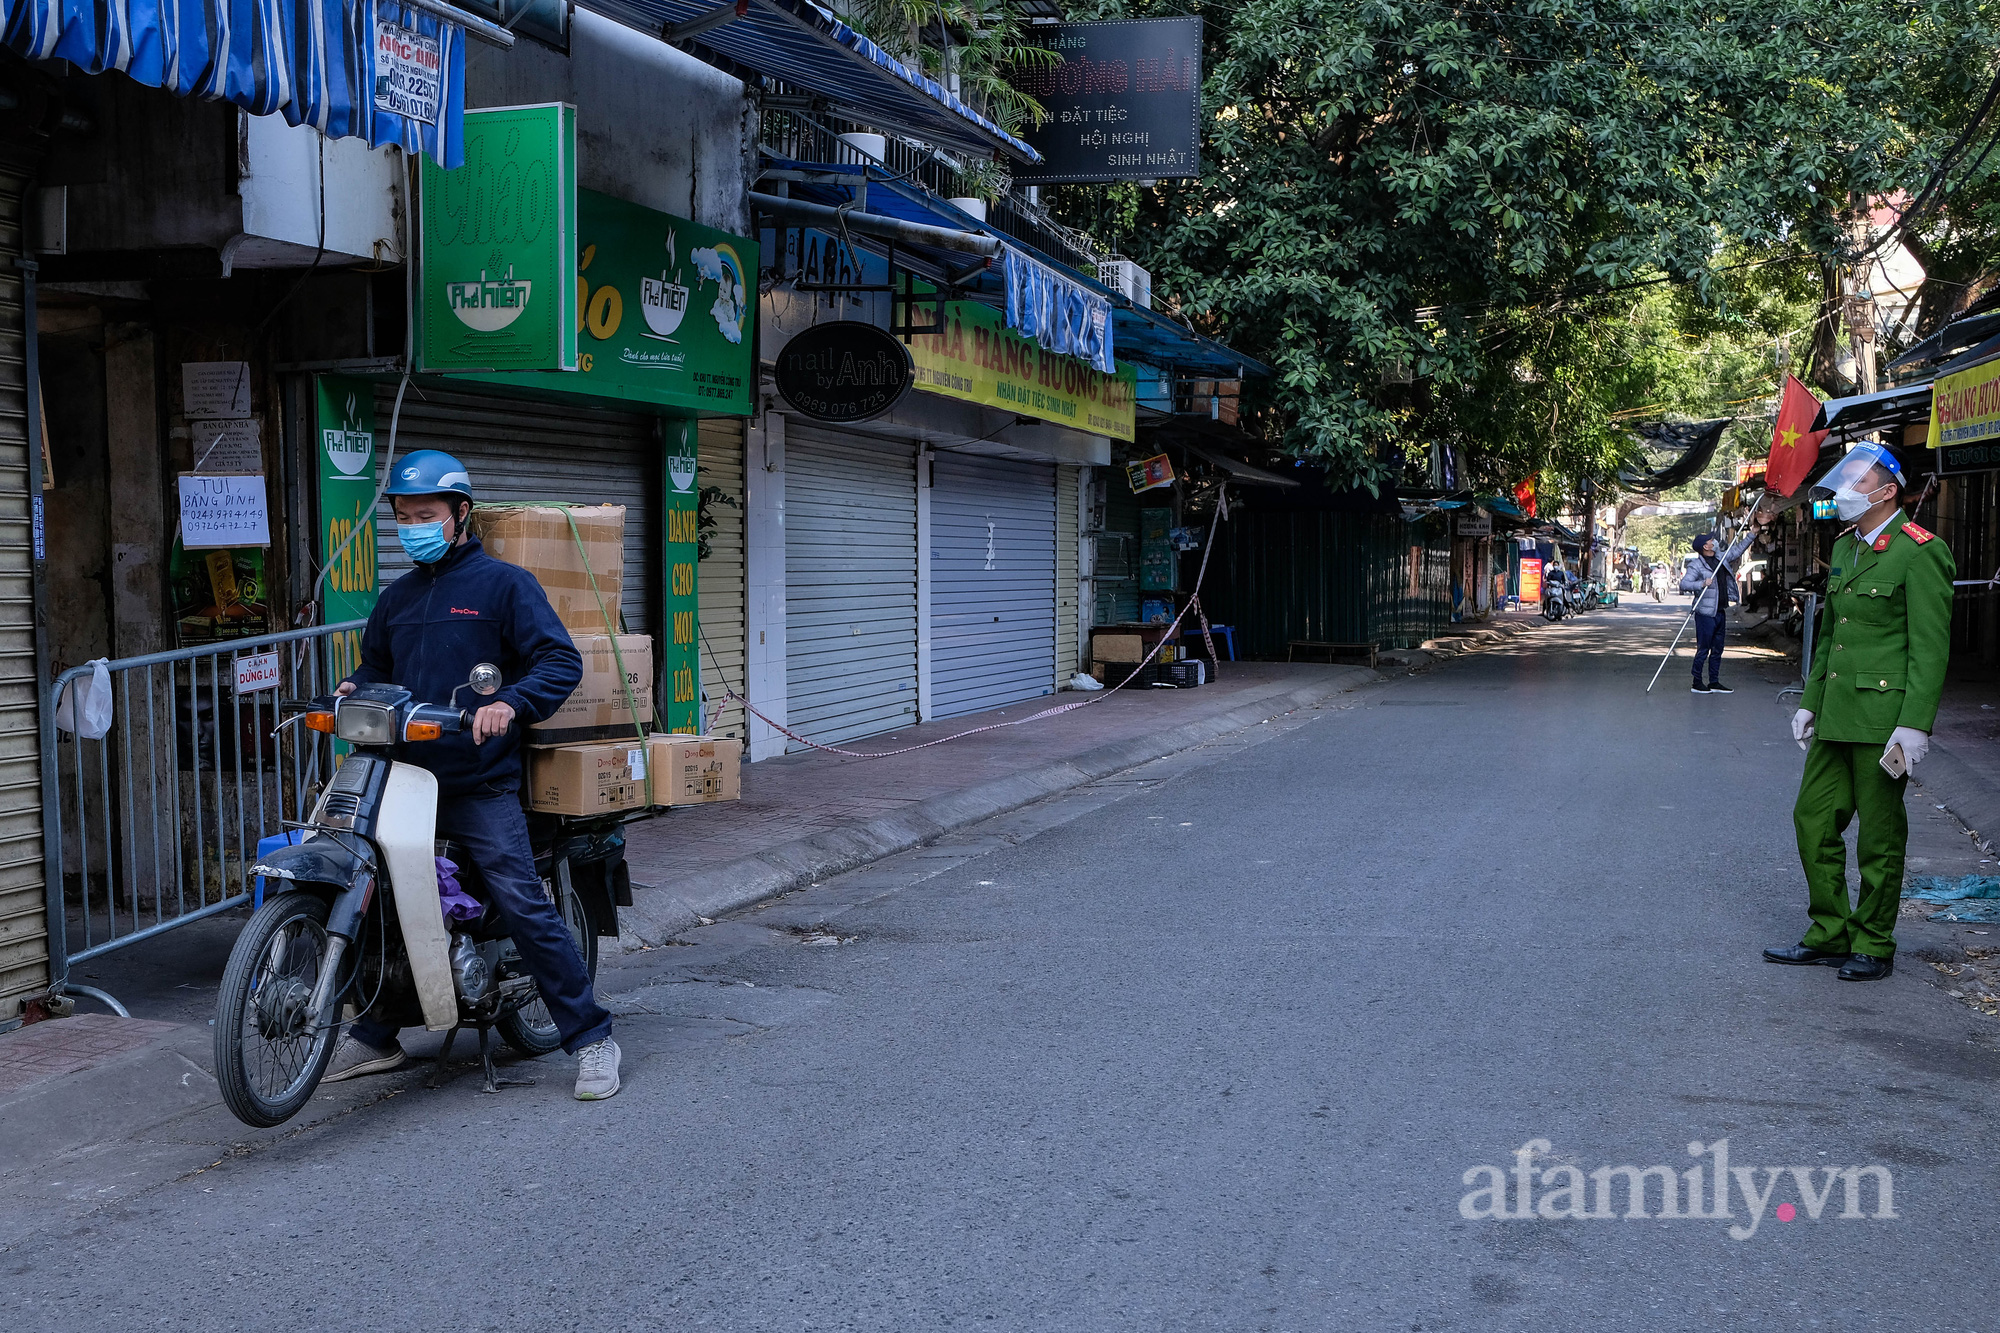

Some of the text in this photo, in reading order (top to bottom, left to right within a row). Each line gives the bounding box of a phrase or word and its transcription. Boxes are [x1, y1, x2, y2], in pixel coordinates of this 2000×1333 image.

[1048, 33, 1085, 50] HÀNG
[1136, 47, 1190, 93] HẢI
[1060, 105, 1091, 126] ĐẶT
[1095, 105, 1127, 124] TIỆC
[1080, 128, 1148, 149] HỘI NGHỊ
[1107, 148, 1187, 168] SINH NHẬT
[788, 347, 834, 371] nail
[911, 303, 967, 362] NHÀ
[973, 319, 1034, 381] HÀNG
[816, 351, 899, 390] by Anh
[795, 390, 886, 415] 0969 076 725
[997, 381, 1077, 420] NHẬN ĐẶT TIỆC SINH NHẬT
[184, 491, 219, 508] BĂNG
[668, 500, 697, 543] DÀNH
[329, 499, 375, 593] CHÁO
[671, 563, 694, 597] CHO
[673, 611, 693, 652] MỌI
[240, 667, 277, 684] DỪNG LẠI
[673, 660, 695, 703] LỨA
